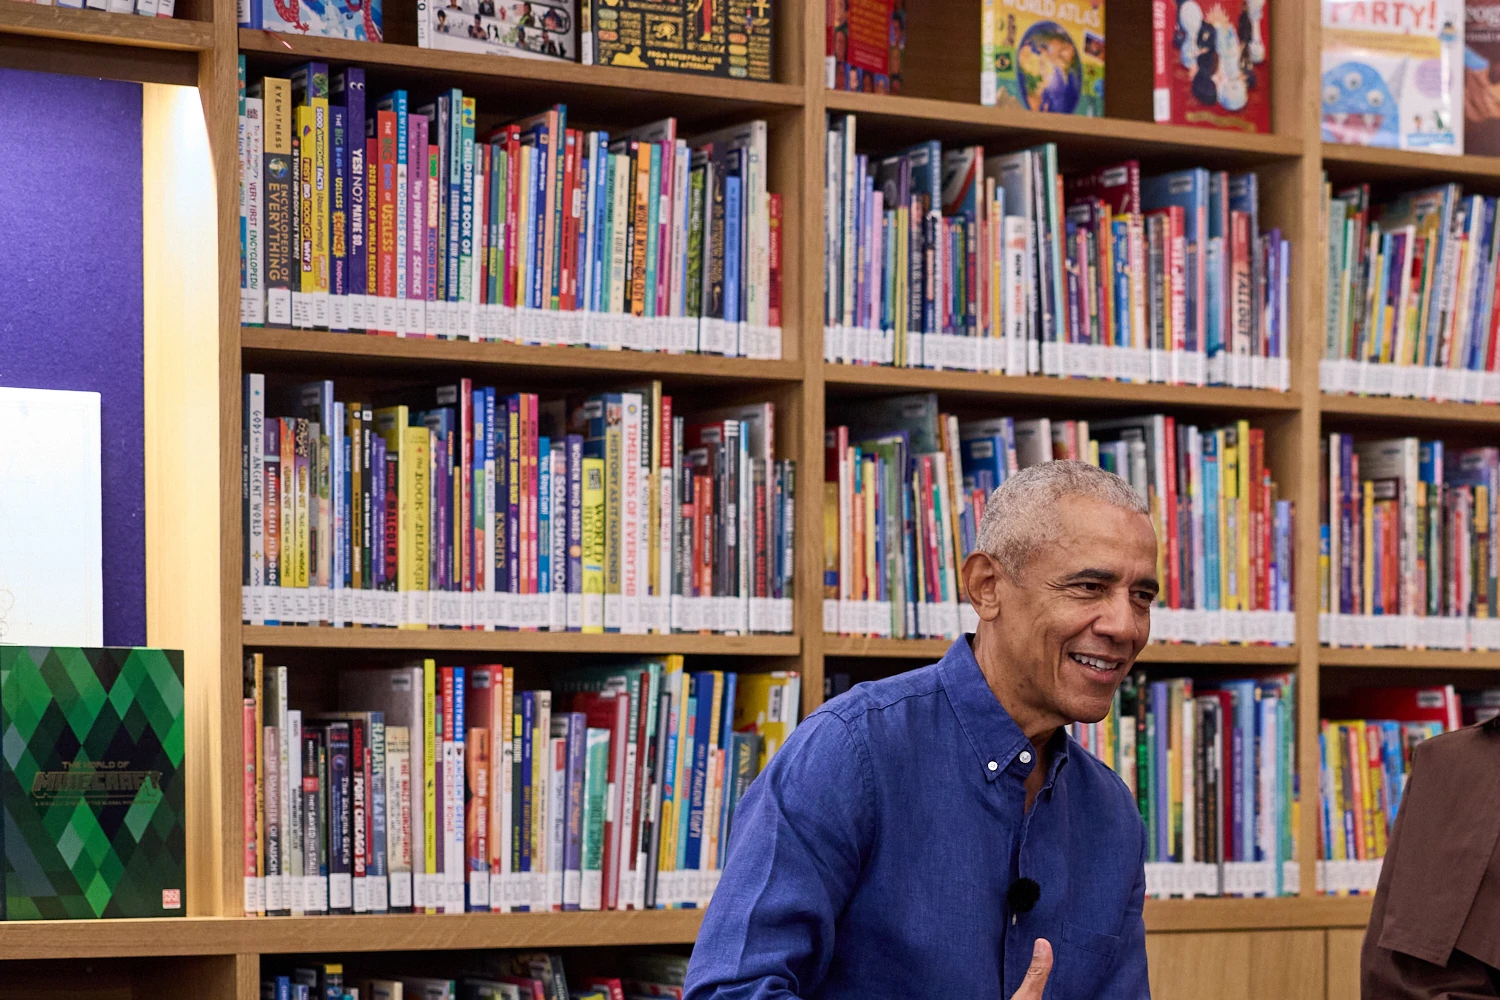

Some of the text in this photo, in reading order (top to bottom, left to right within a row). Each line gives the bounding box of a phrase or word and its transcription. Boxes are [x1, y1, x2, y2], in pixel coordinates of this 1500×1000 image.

[1057, 3, 1101, 28] ATLAS
[275, 85, 283, 149] EYEWITNESS
[316, 128, 324, 190] AWESOME FACTS
[249, 182, 258, 227] VERY FIRST
[303, 157, 311, 263] FIRST BIG BOOK WHY
[334, 128, 345, 254] BIG USELESS SCIENCE
[352, 149, 363, 233] YES! NO? MAYBE
[382, 121, 395, 252] THE BIG OF USELESS
[398, 98, 407, 268] EYEWITNESS WONDERS OF THE
[463, 138, 473, 255] CHILDREN'S BOOK OF
[268, 182, 281, 281] EVERYTHING
[280, 183, 289, 282] ENCYCLOPEDIA OF
[368, 185, 377, 293] BOOK OF WORLD RECORDS
[411, 180, 424, 295] Very IMPORTANT SCIENCE
[252, 410, 262, 537] GODS ANCIENT WORLD
[414, 472, 425, 510] BOOK
[555, 476, 566, 513] SOLE
[571, 443, 581, 540] WOMEN WHO DARED
[609, 434, 618, 584] HISTORY AS IT HAPPENED
[626, 422, 638, 517] TIMELINES OF
[386, 500, 396, 569] MALCOLM X
[495, 511, 506, 569] KNIGHTS
[583, 506, 593, 559] HISTORY
[594, 502, 605, 562] WORLD
[455, 676, 463, 739] EYEWITNESS
[33, 770, 161, 798] MINECRAFT
[354, 777, 364, 873] PORT CHICAGO 50
[372, 722, 385, 833] RADAR RAFT
